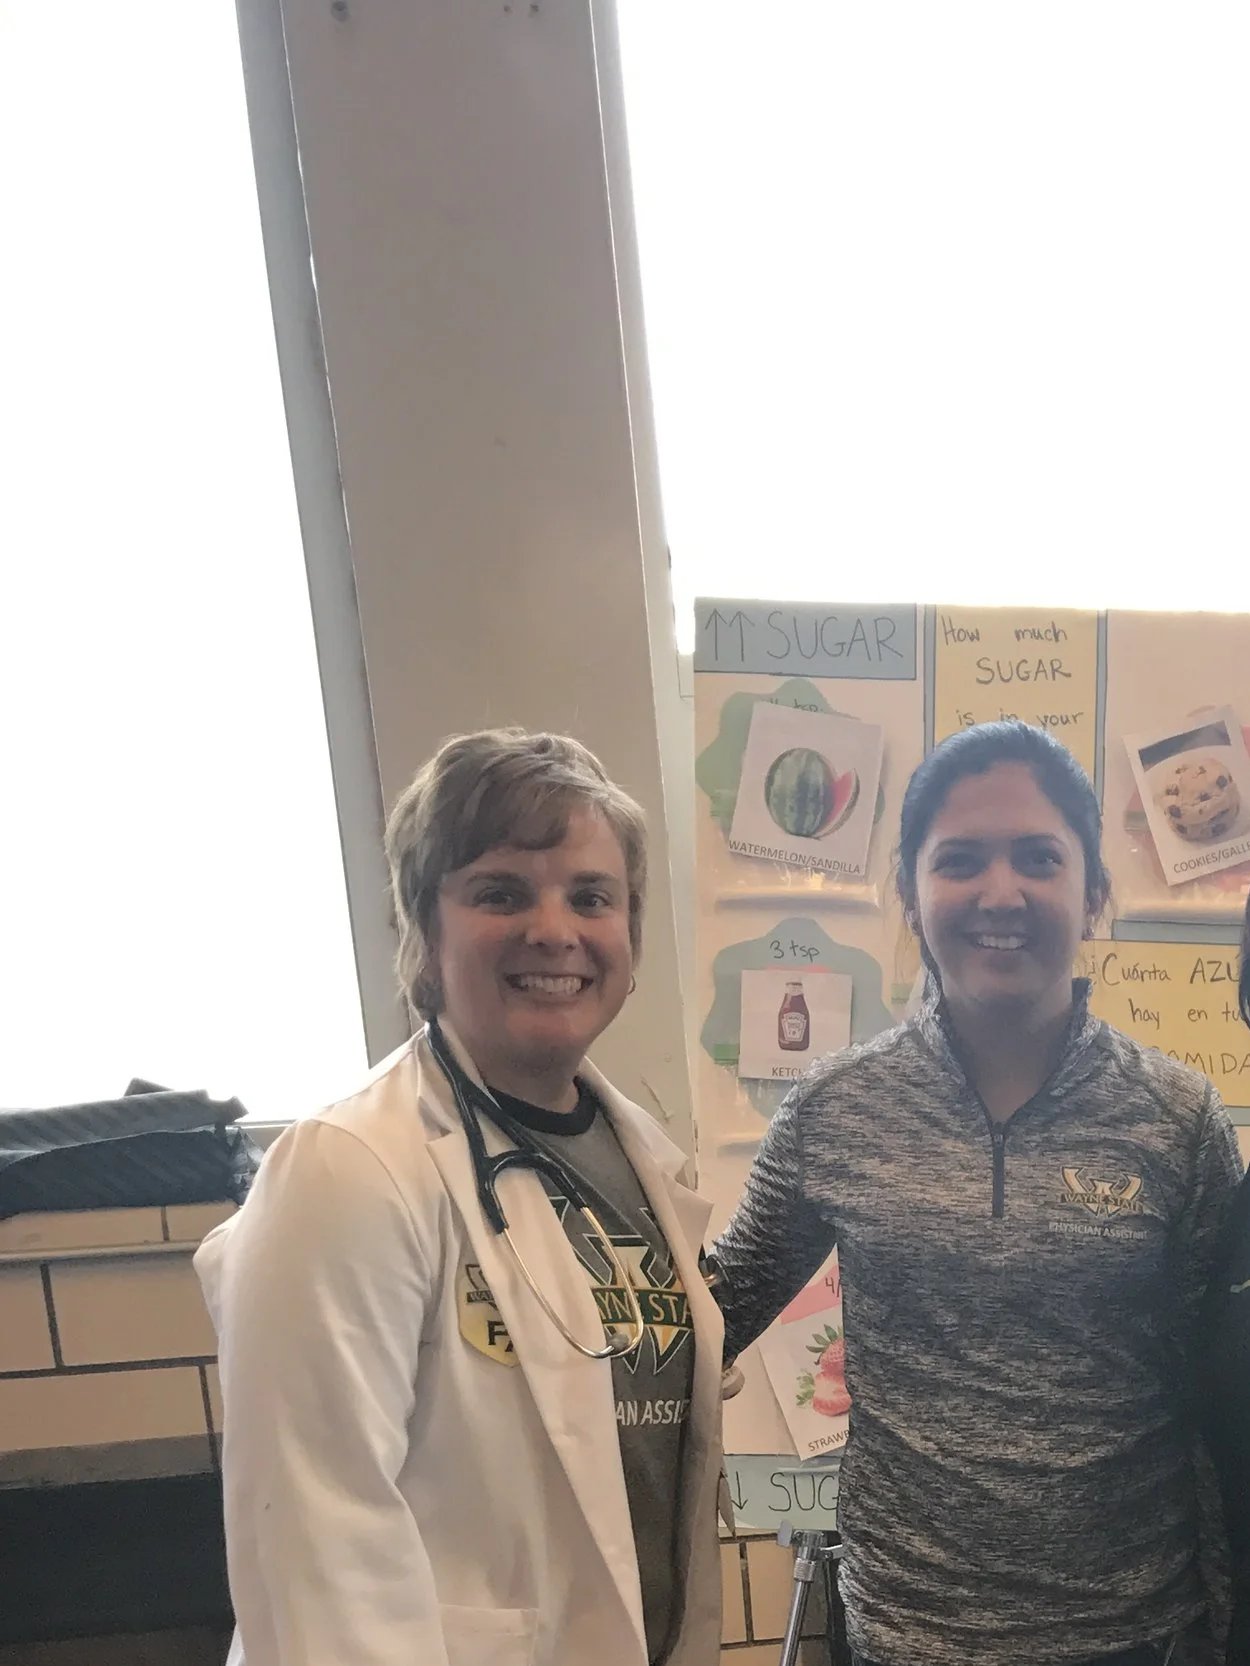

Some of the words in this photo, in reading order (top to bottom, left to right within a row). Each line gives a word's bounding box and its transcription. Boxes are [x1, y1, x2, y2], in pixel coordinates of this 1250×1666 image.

[766, 610, 904, 662] SUGAR
[941, 615, 980, 645] How
[1014, 621, 1068, 643] much
[976, 657, 1072, 685] SUGAR
[955, 709, 976, 726] is
[729, 839, 861, 874] WATERMELON/SANDILLA
[769, 940, 785, 959] 3
[789, 940, 820, 962] tsp
[1128, 998, 1160, 1030] hay
[1187, 1007, 1208, 1022] en
[1049, 1222, 1101, 1236] PHYSICIAN
